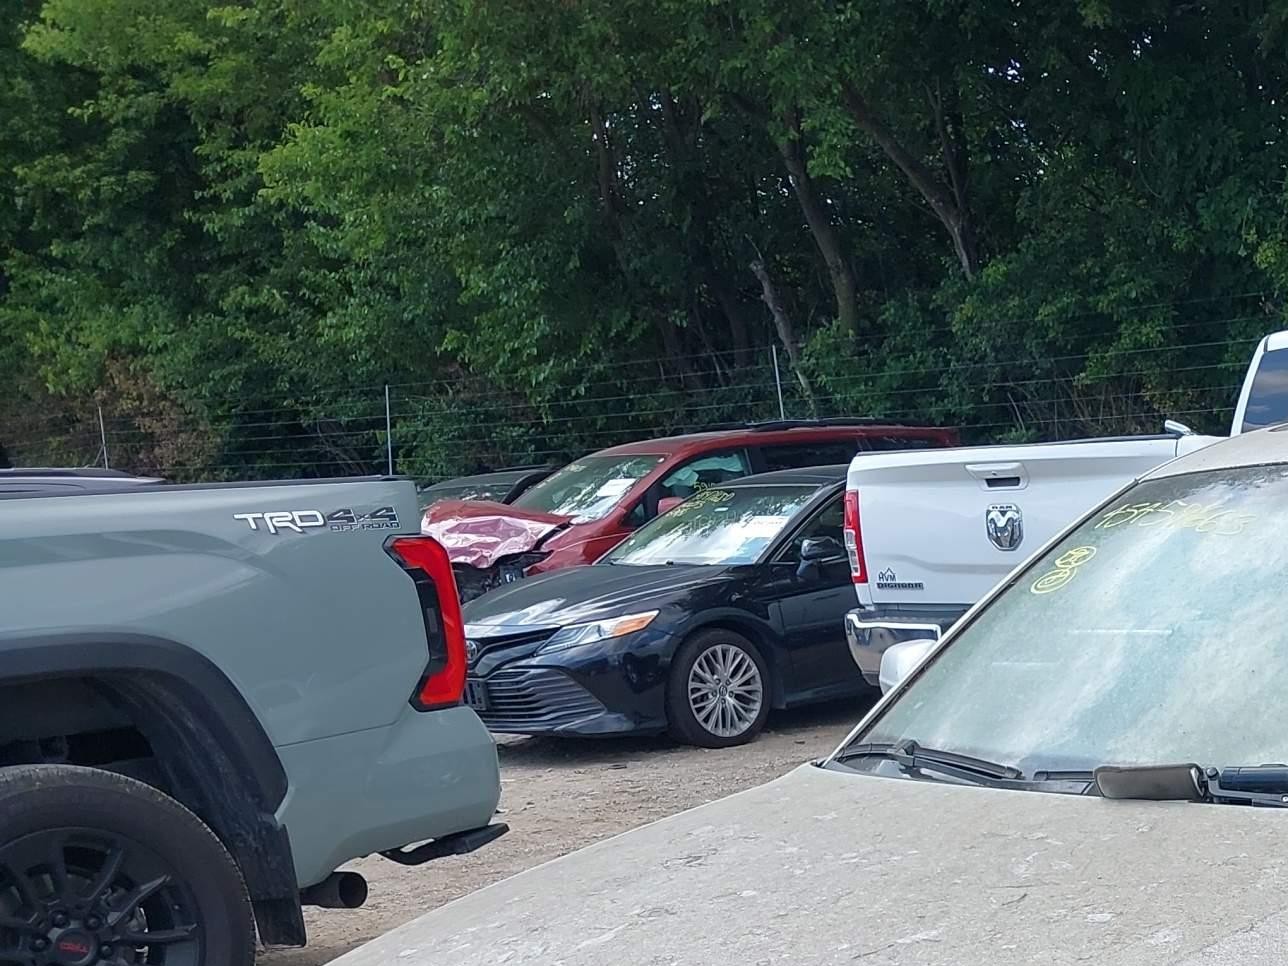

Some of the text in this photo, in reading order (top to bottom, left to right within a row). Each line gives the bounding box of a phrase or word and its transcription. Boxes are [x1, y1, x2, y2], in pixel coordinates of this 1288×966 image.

[233, 510, 327, 535] TRD
[330, 521, 400, 533] OFF ROAD
